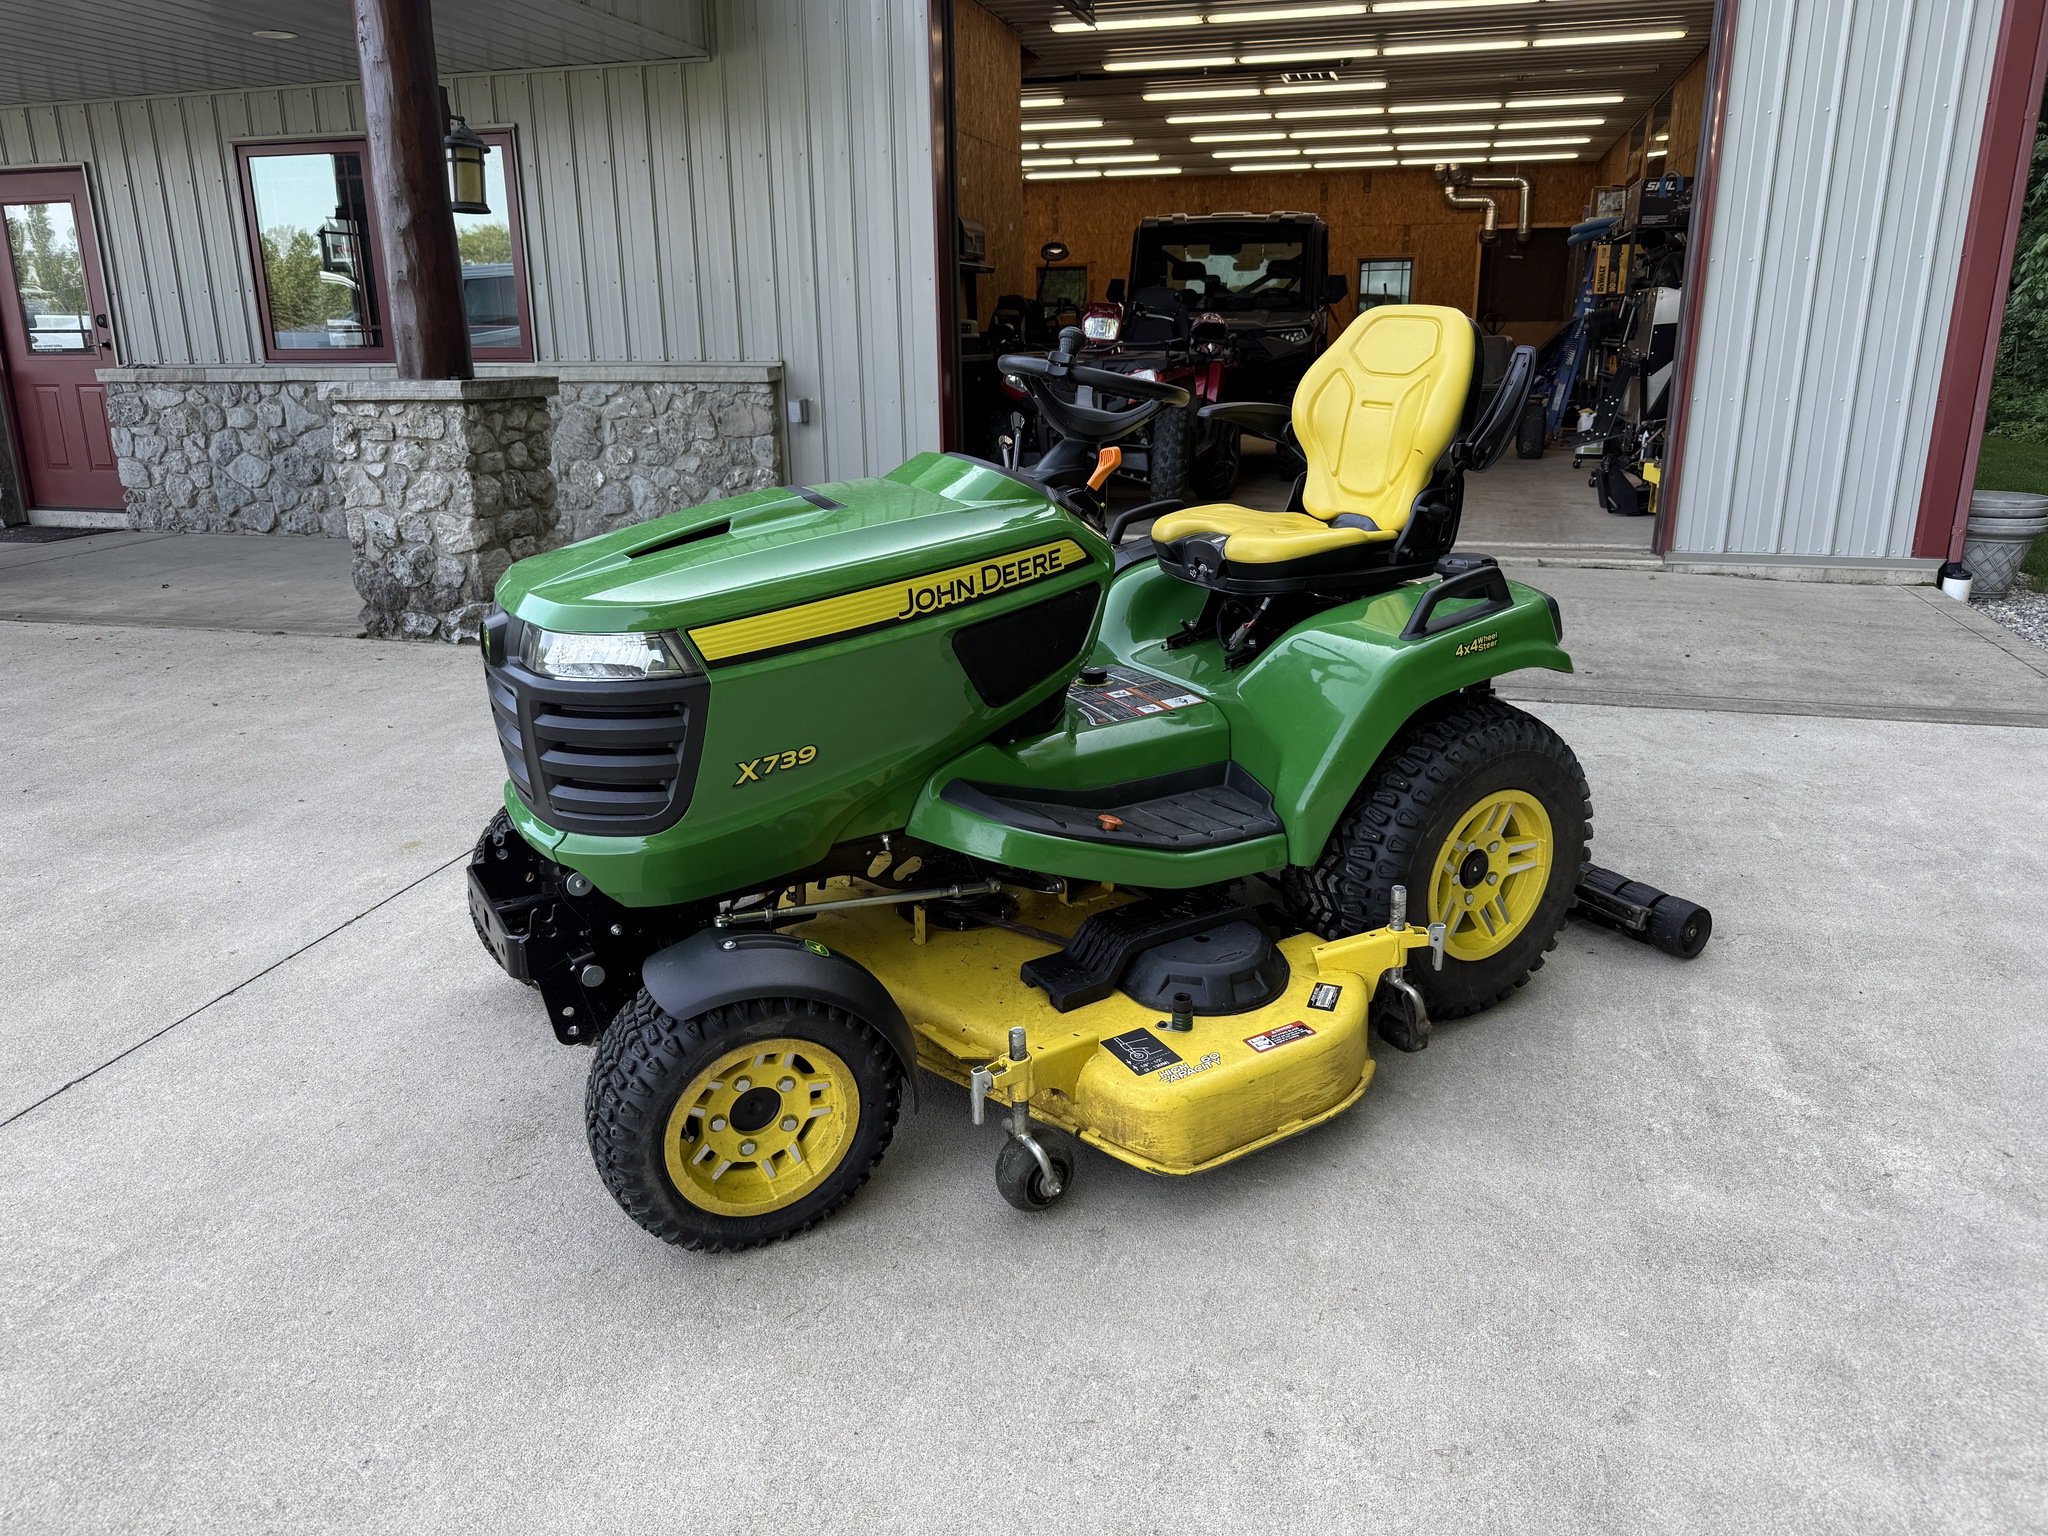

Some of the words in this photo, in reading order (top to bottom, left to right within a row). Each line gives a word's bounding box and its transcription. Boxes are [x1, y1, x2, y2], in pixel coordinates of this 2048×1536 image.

[899, 575, 976, 617] JOHN
[981, 548, 1063, 592] DEERE
[1455, 638, 1478, 657] 4x4
[1477, 631, 1498, 644] Wheel
[1478, 639, 1498, 652] Steer
[731, 744, 818, 787] X739
[1200, 1052, 1221, 1064] 60
[1158, 1062, 1190, 1080] HIGH
